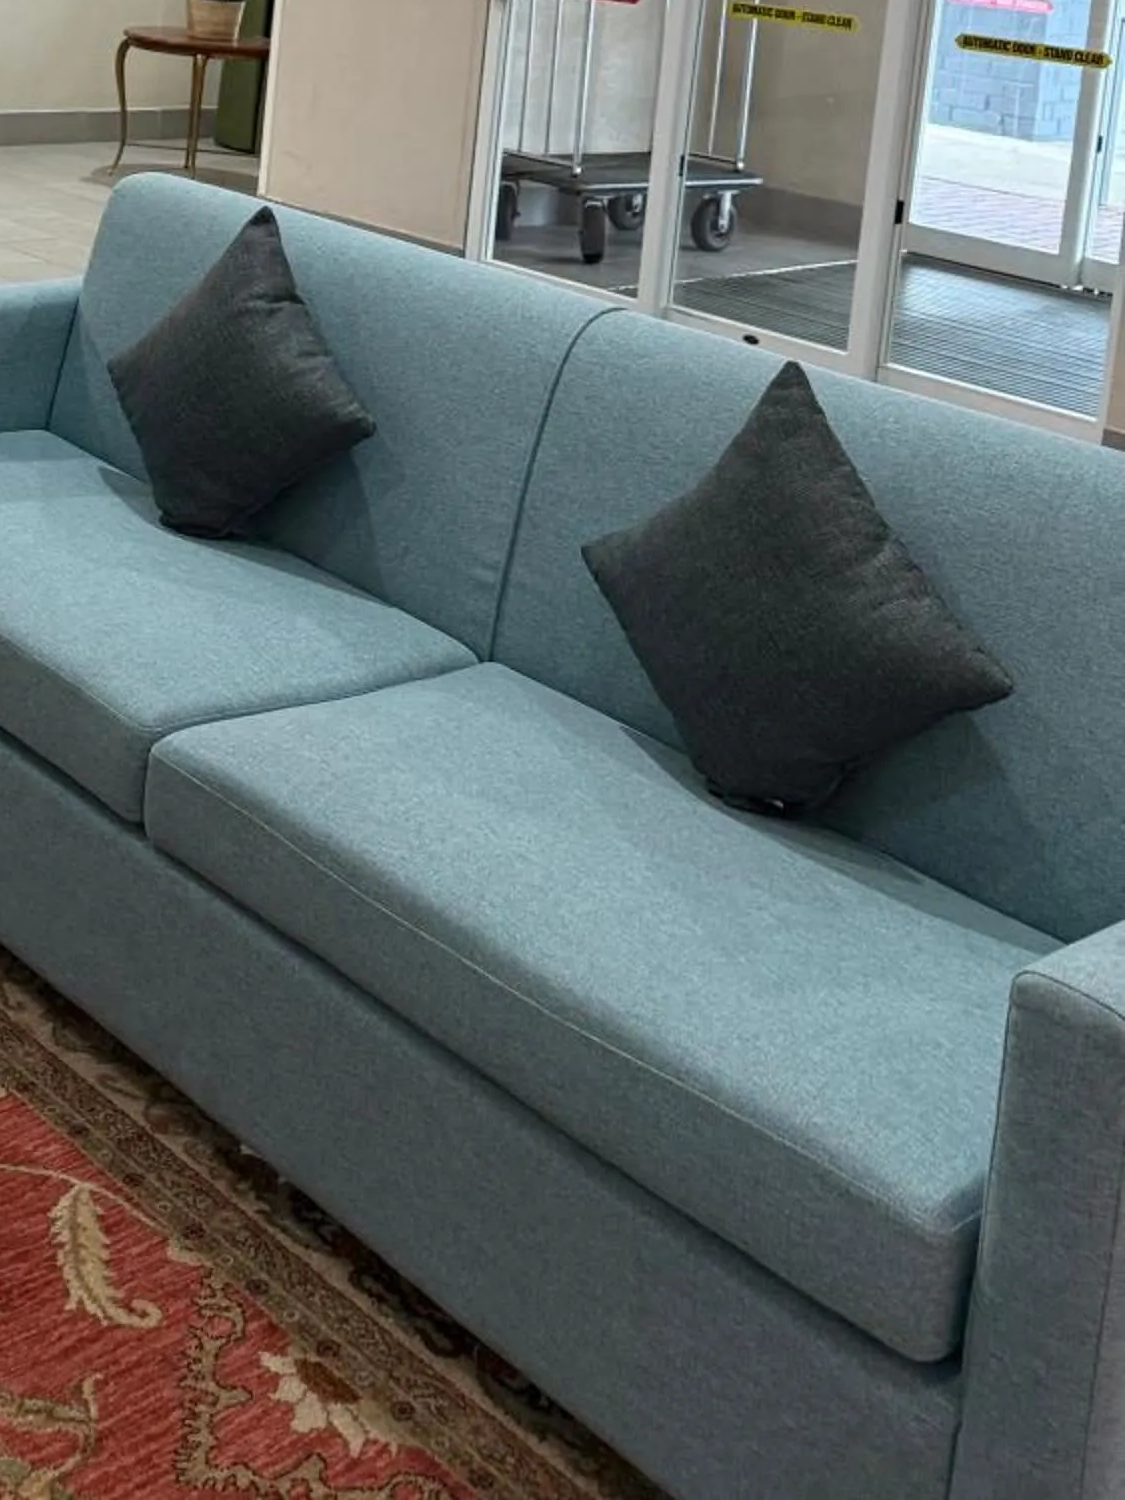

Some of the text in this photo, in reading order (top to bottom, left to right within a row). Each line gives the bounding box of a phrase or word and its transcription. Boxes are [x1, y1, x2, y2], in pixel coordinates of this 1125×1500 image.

[963, 35, 1012, 50] AUTOMATIC
[1045, 45, 1073, 61] STAND
[1074, 49, 1104, 66] CLEAR
